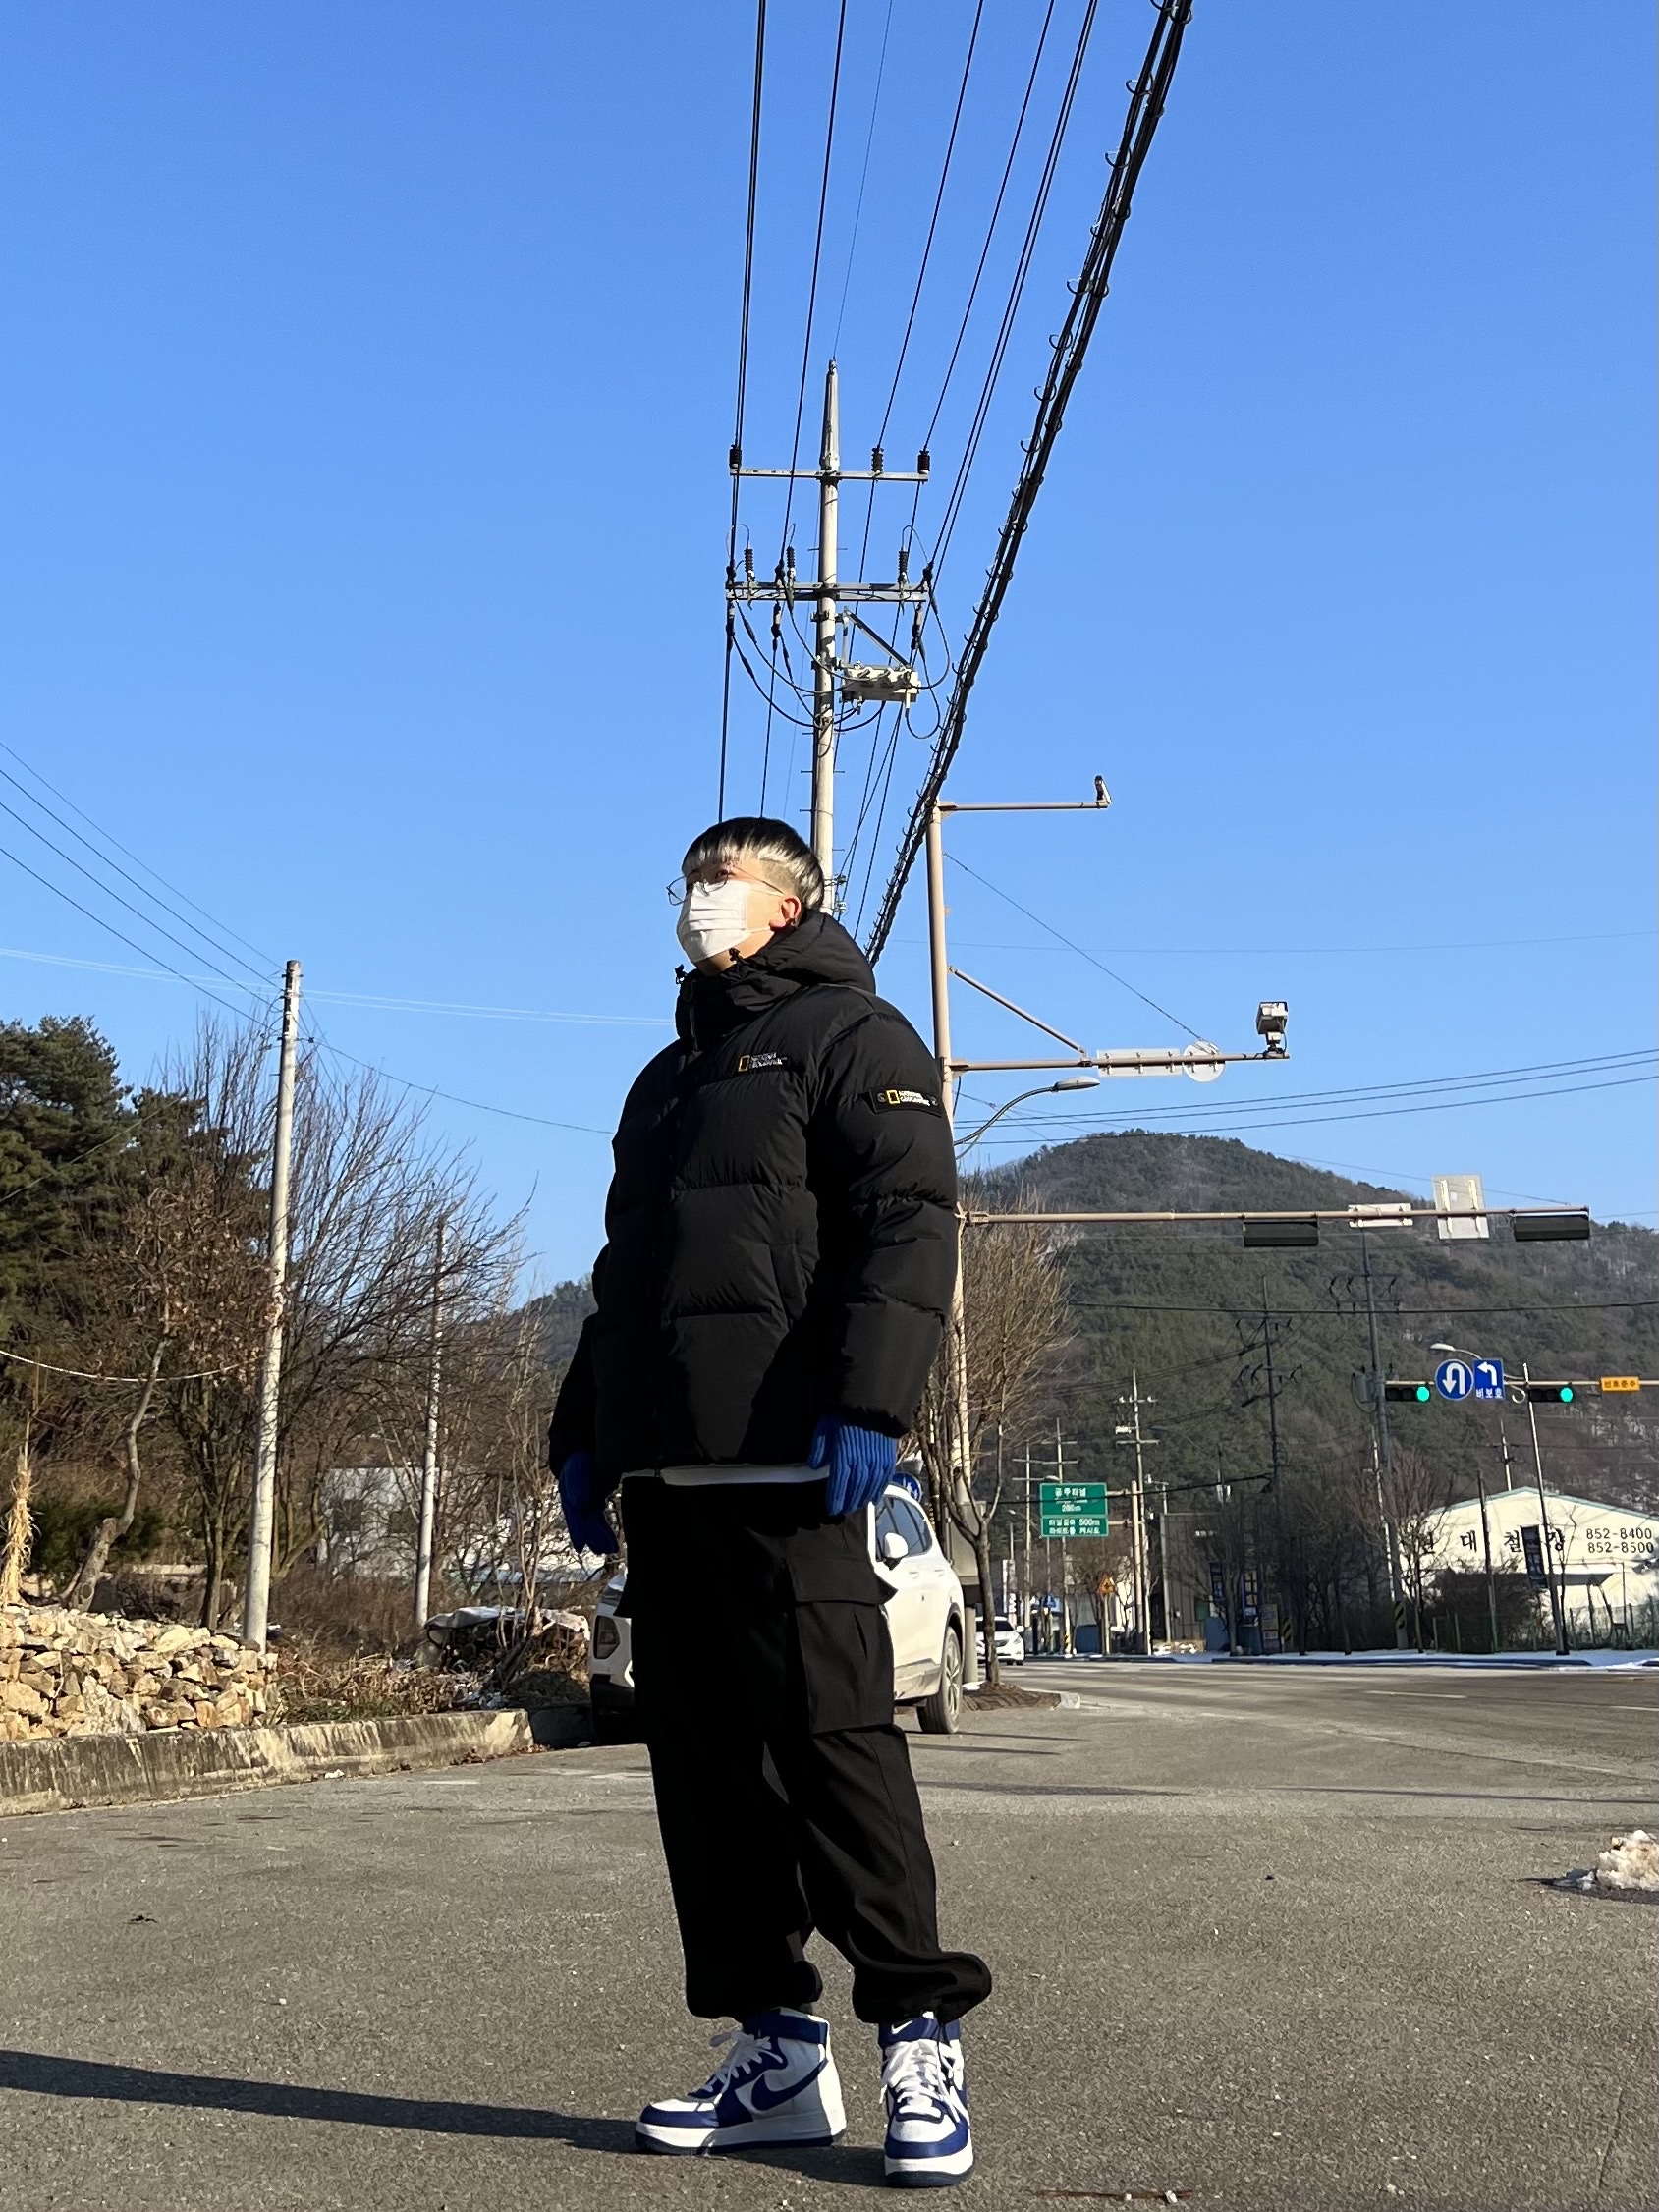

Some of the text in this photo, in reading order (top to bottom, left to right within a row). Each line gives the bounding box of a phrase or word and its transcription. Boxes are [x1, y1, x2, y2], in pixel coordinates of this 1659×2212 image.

[1476, 1388, 1503, 1399] 비보호
[1586, 1528, 1652, 1540] 852-8400
[1588, 1542, 1654, 1553] 852-8500
